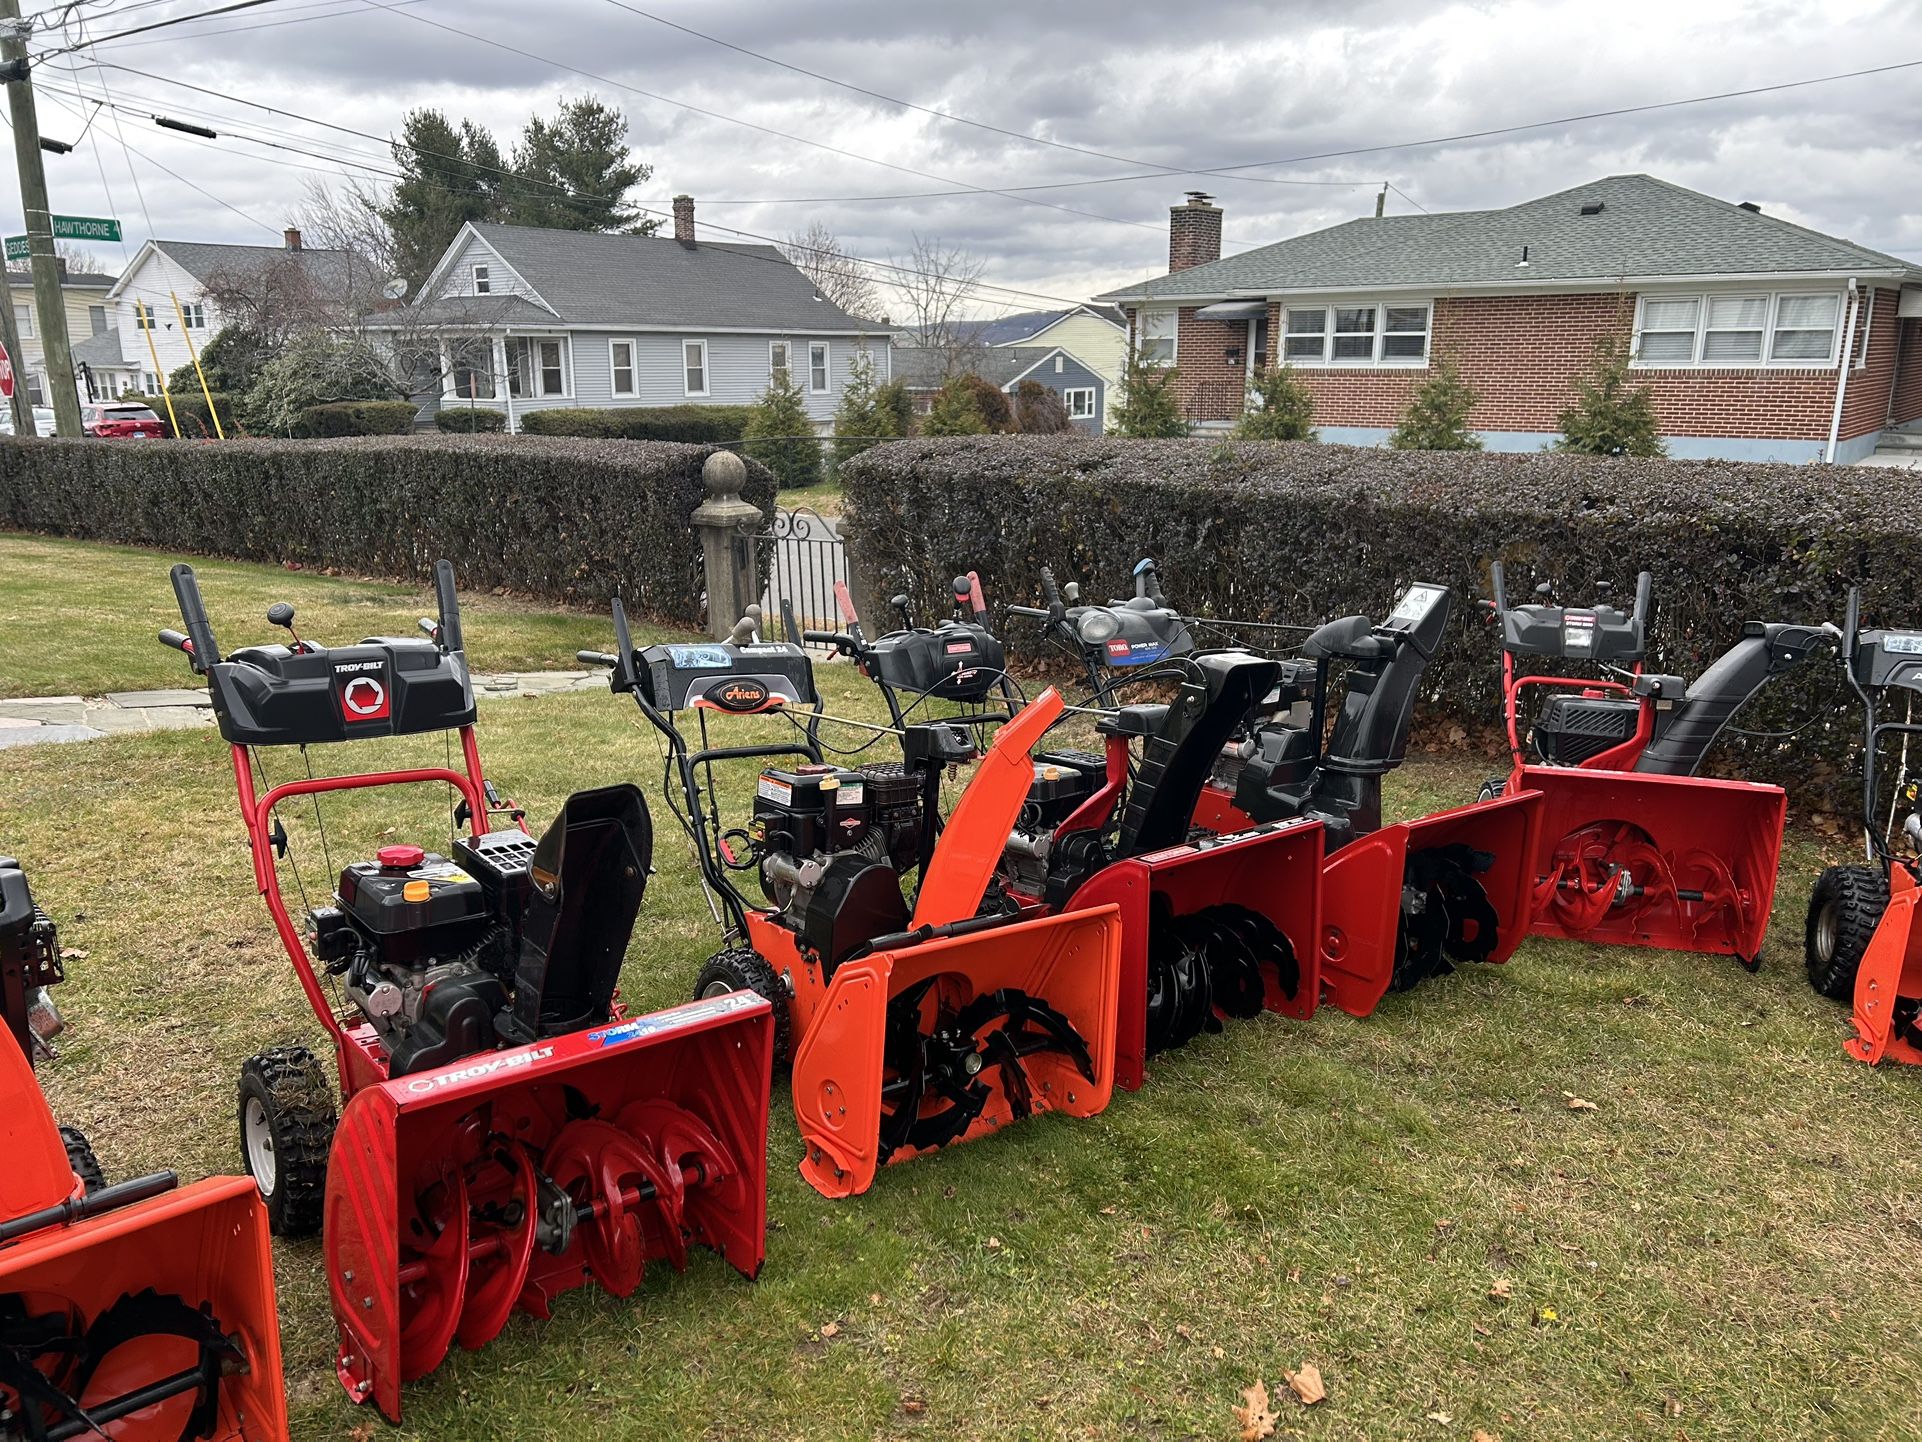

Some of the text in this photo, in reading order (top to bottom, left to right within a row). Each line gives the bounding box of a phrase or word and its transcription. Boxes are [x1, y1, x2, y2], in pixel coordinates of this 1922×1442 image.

[55, 221, 110, 236] HAWTHORNE
[6, 240, 30, 256] GEDDES
[739, 646, 776, 654] Compact
[1108, 643, 1129, 652] TORO
[334, 661, 384, 673] TROY-BILT
[725, 686, 760, 700] Ariens
[587, 1021, 640, 1042] STORM
[433, 1046, 555, 1086] TROY-BILT
